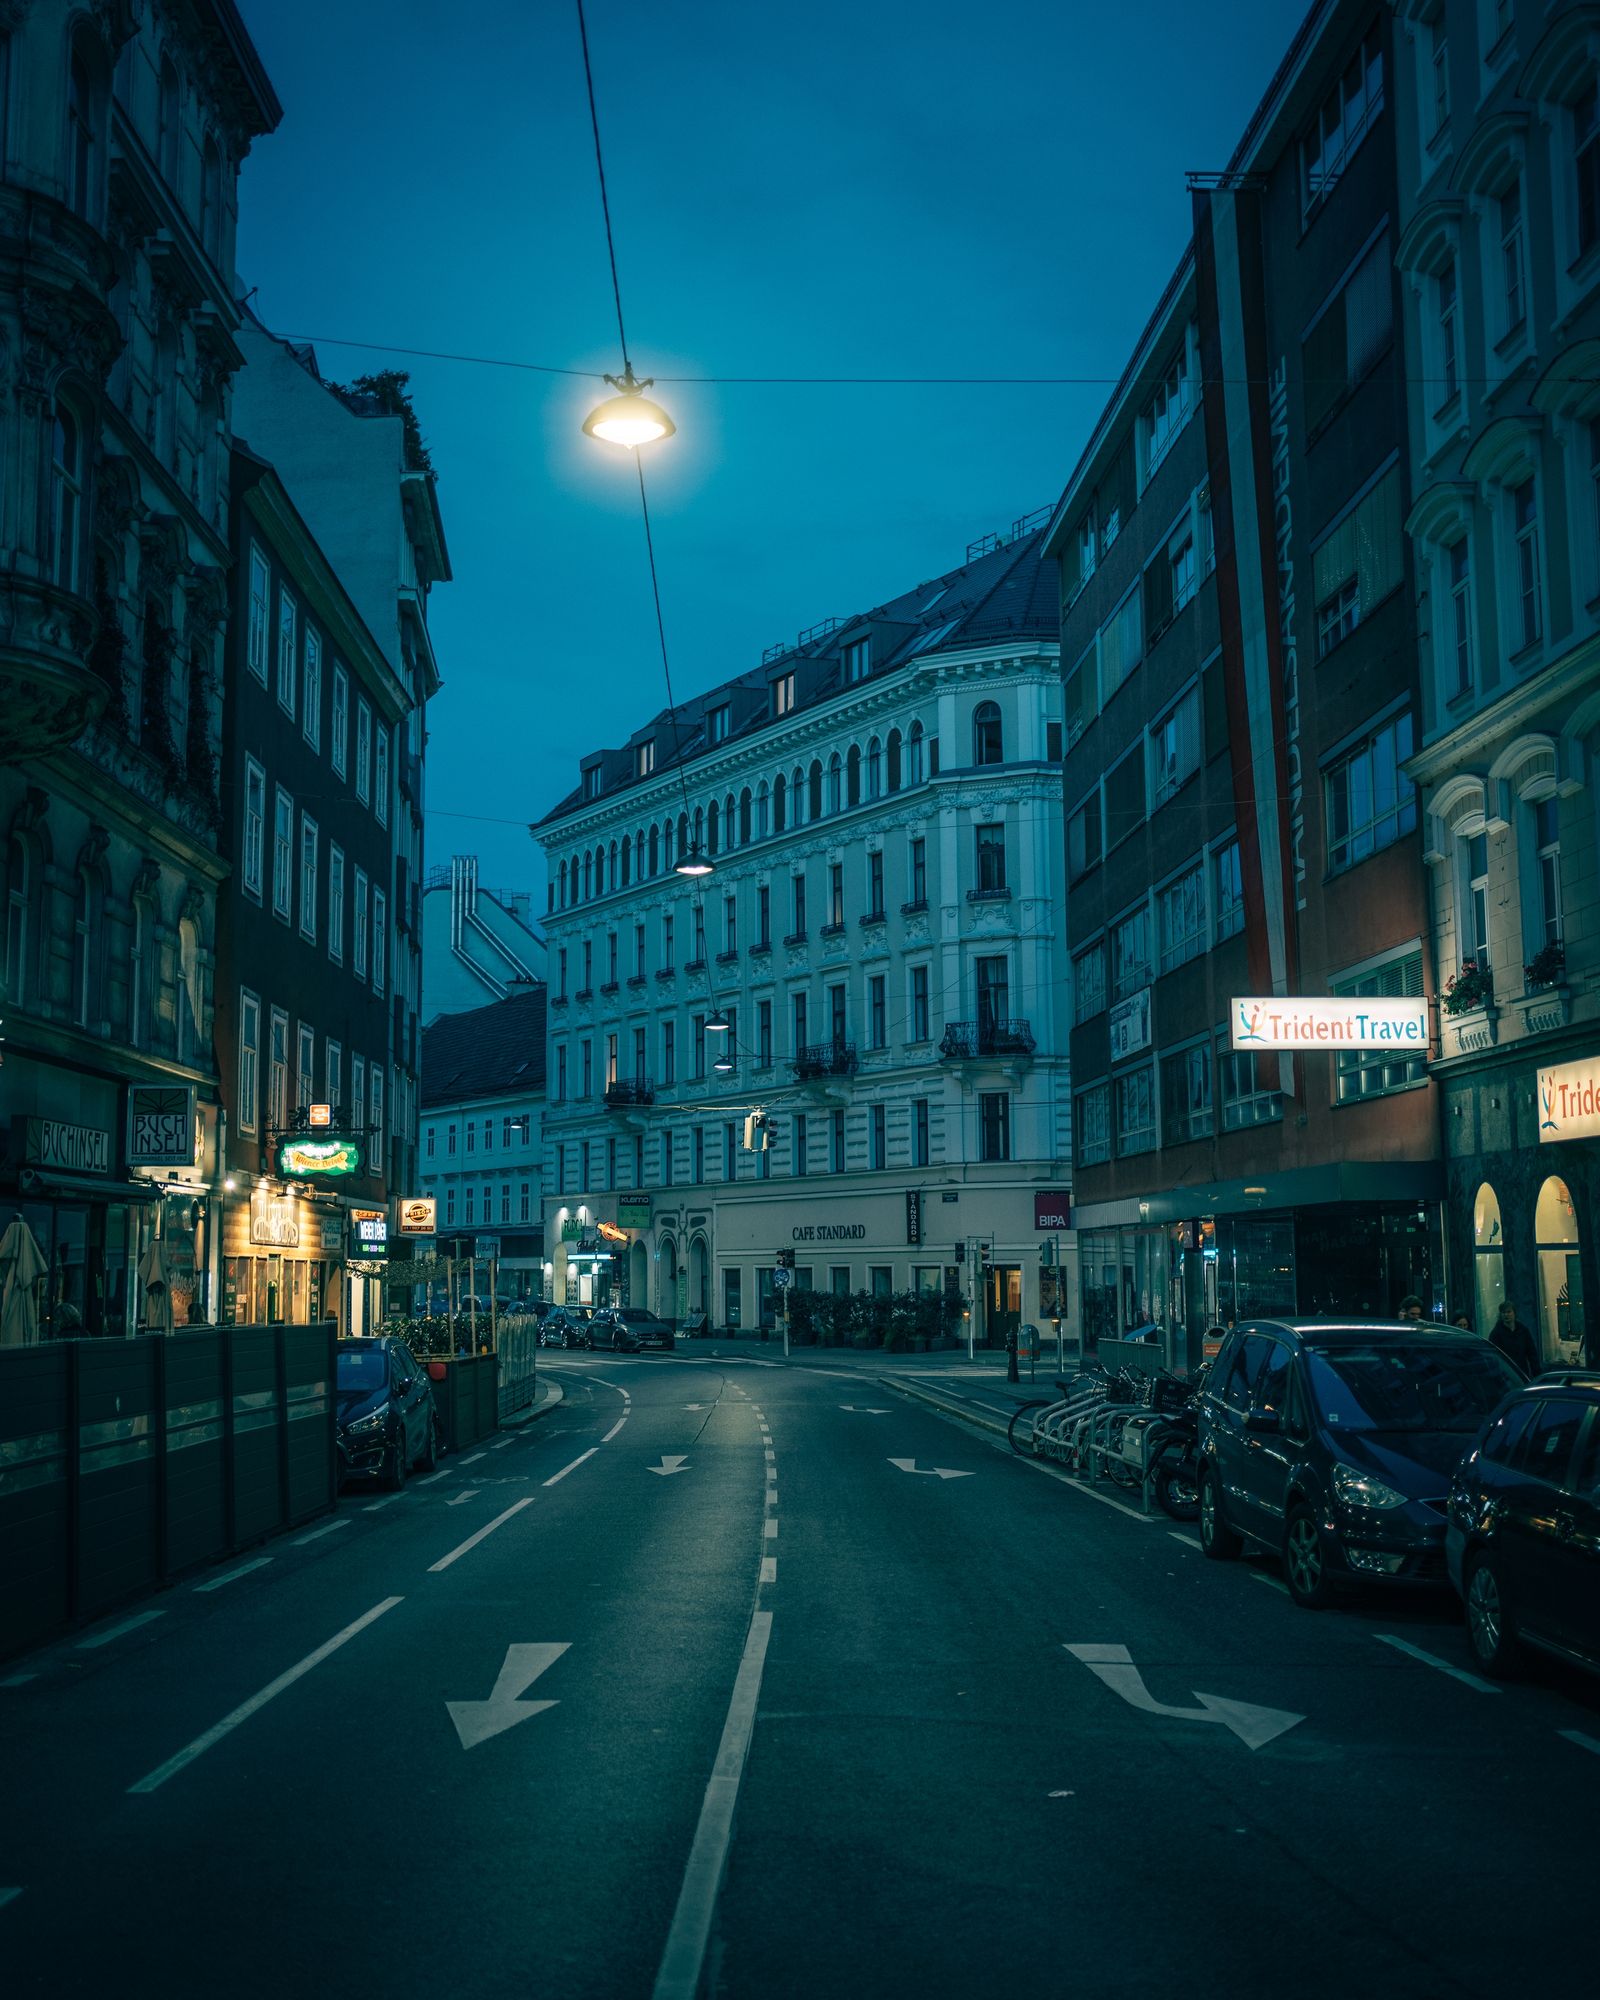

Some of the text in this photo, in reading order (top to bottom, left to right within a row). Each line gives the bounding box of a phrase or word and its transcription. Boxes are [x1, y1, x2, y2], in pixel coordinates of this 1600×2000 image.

[1268, 356, 1306, 911] HANDELSAKADEMIE
[135, 1116, 186, 1136] BUCH
[43, 1121, 107, 1171] BUCHINSEL
[134, 1134, 187, 1153] INSEL
[1039, 1215, 1066, 1227] BIPA
[792, 1224, 866, 1241] CAFE STANDARD
